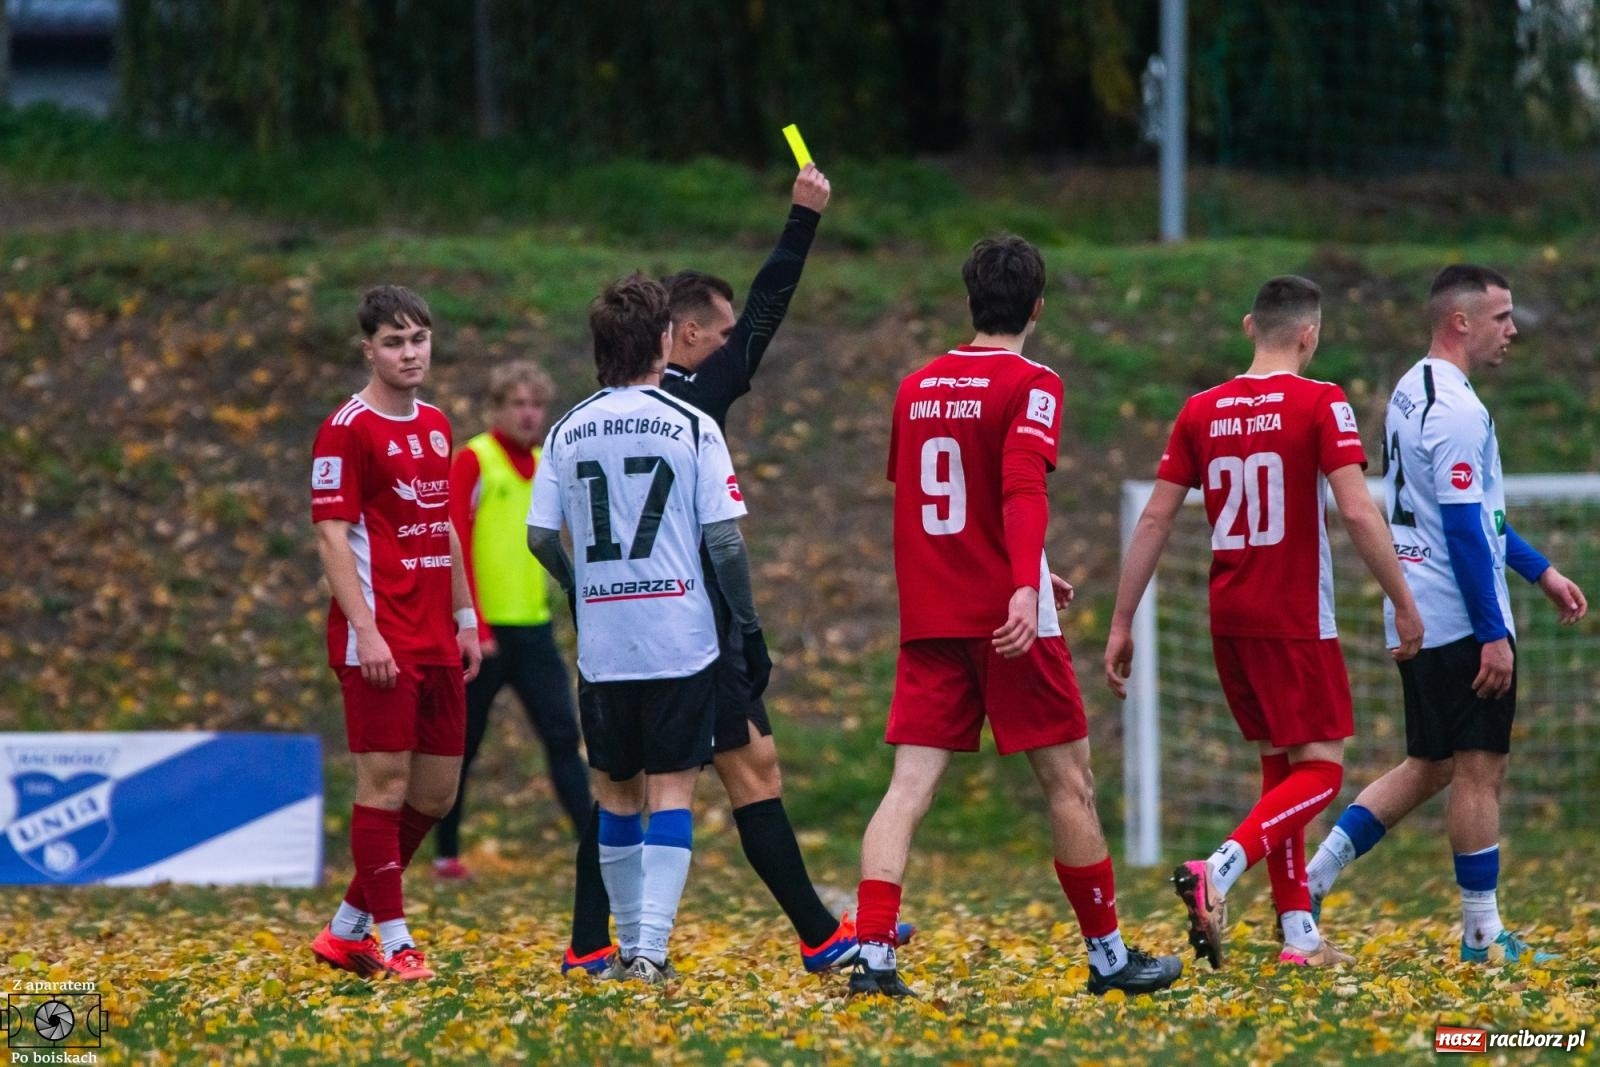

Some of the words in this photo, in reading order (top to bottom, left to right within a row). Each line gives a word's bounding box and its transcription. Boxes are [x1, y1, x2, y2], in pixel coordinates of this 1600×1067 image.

[910, 400, 941, 420] UNIA
[1038, 396, 1049, 411] 3
[564, 421, 597, 445] UNIA
[603, 417, 684, 441] RACIBÓRZ
[1210, 417, 1243, 438] UNIA
[920, 436, 967, 536] 9
[1208, 451, 1285, 551] 20
[576, 455, 675, 563] 17
[17, 797, 99, 842] UNIA
